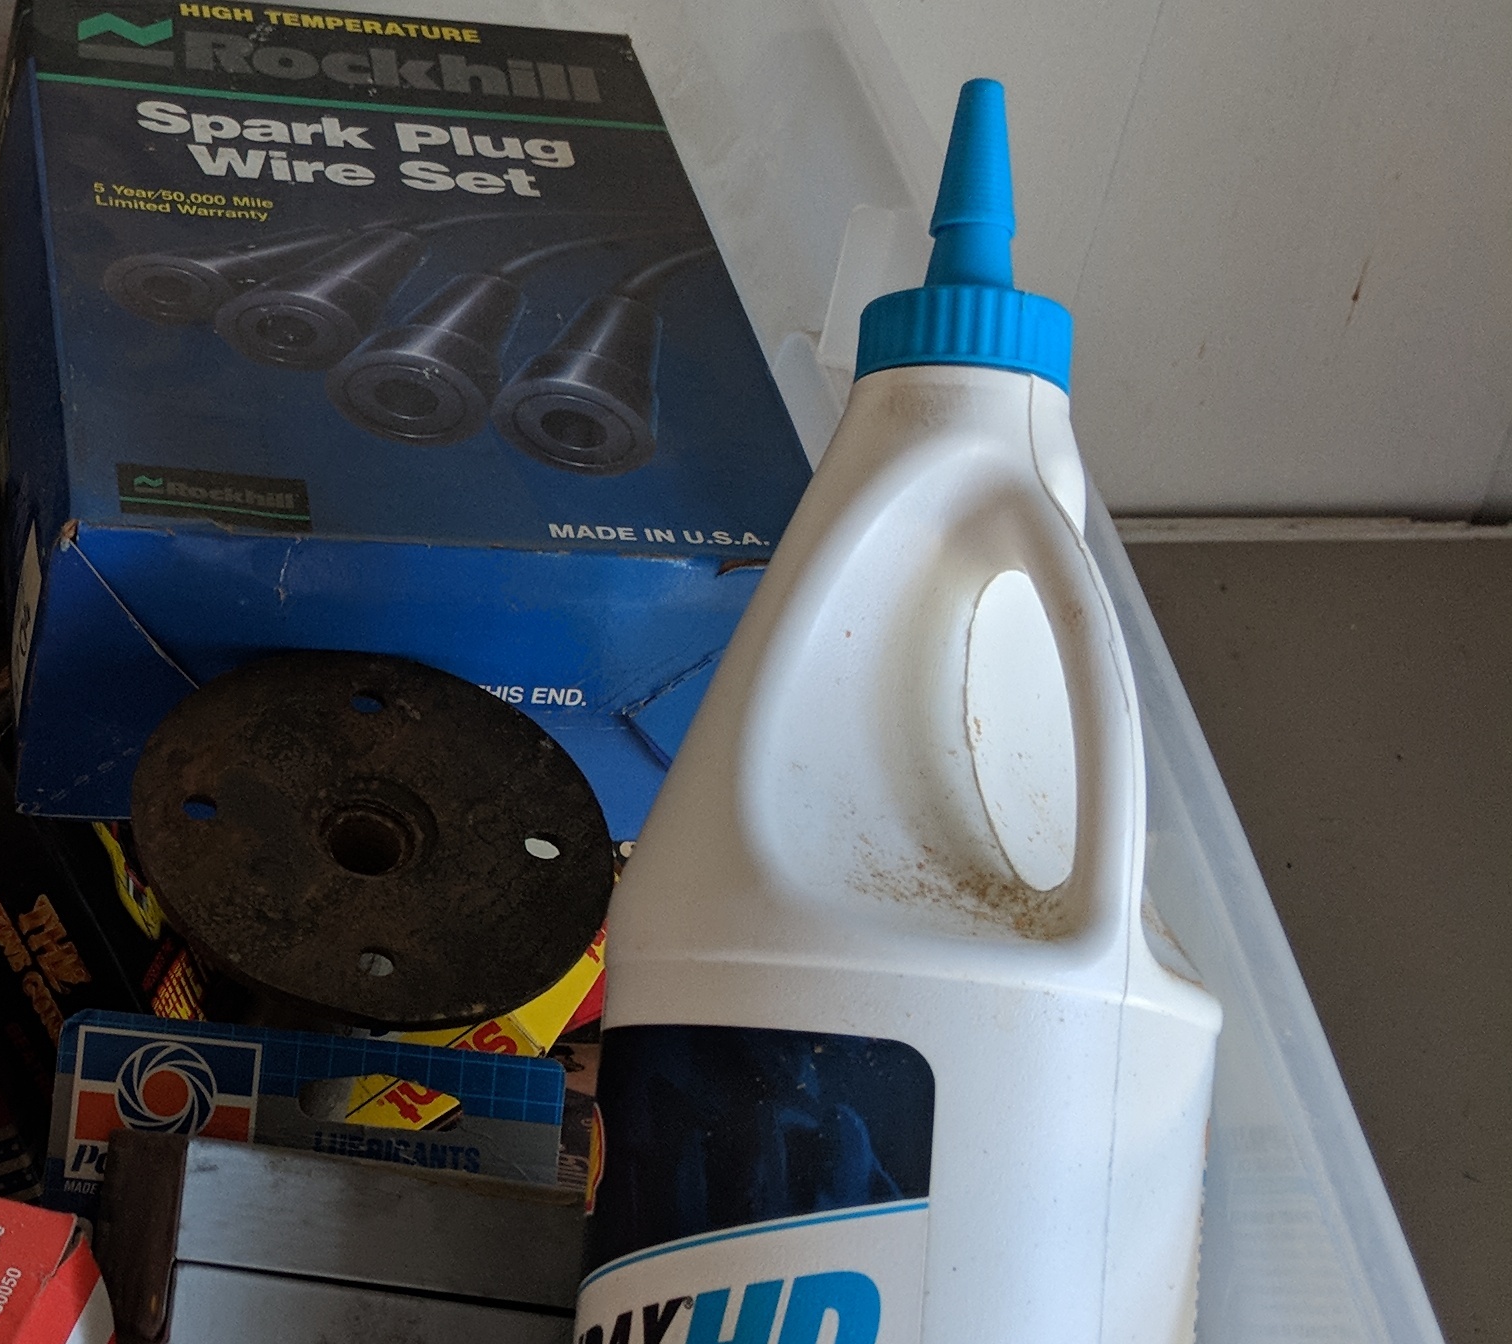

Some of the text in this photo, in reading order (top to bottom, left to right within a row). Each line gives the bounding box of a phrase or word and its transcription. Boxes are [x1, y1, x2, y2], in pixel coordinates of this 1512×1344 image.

[179, 2, 482, 44] HIGH TEMPERATURE
[184, 30, 602, 104] Rockhill
[136, 100, 576, 169] Spark Plug
[186, 143, 542, 198] Wire Set
[92, 181, 106, 194] 5
[232, 196, 274, 209] Mile
[94, 195, 269, 223] Limited Warranty
[166, 479, 299, 510] Rockhill
[548, 523, 771, 547] MADE IN U.S.A.
[531, 686, 587, 708] END.
[18, 894, 92, 995] THE
[63, 1180, 98, 1195] MADE
